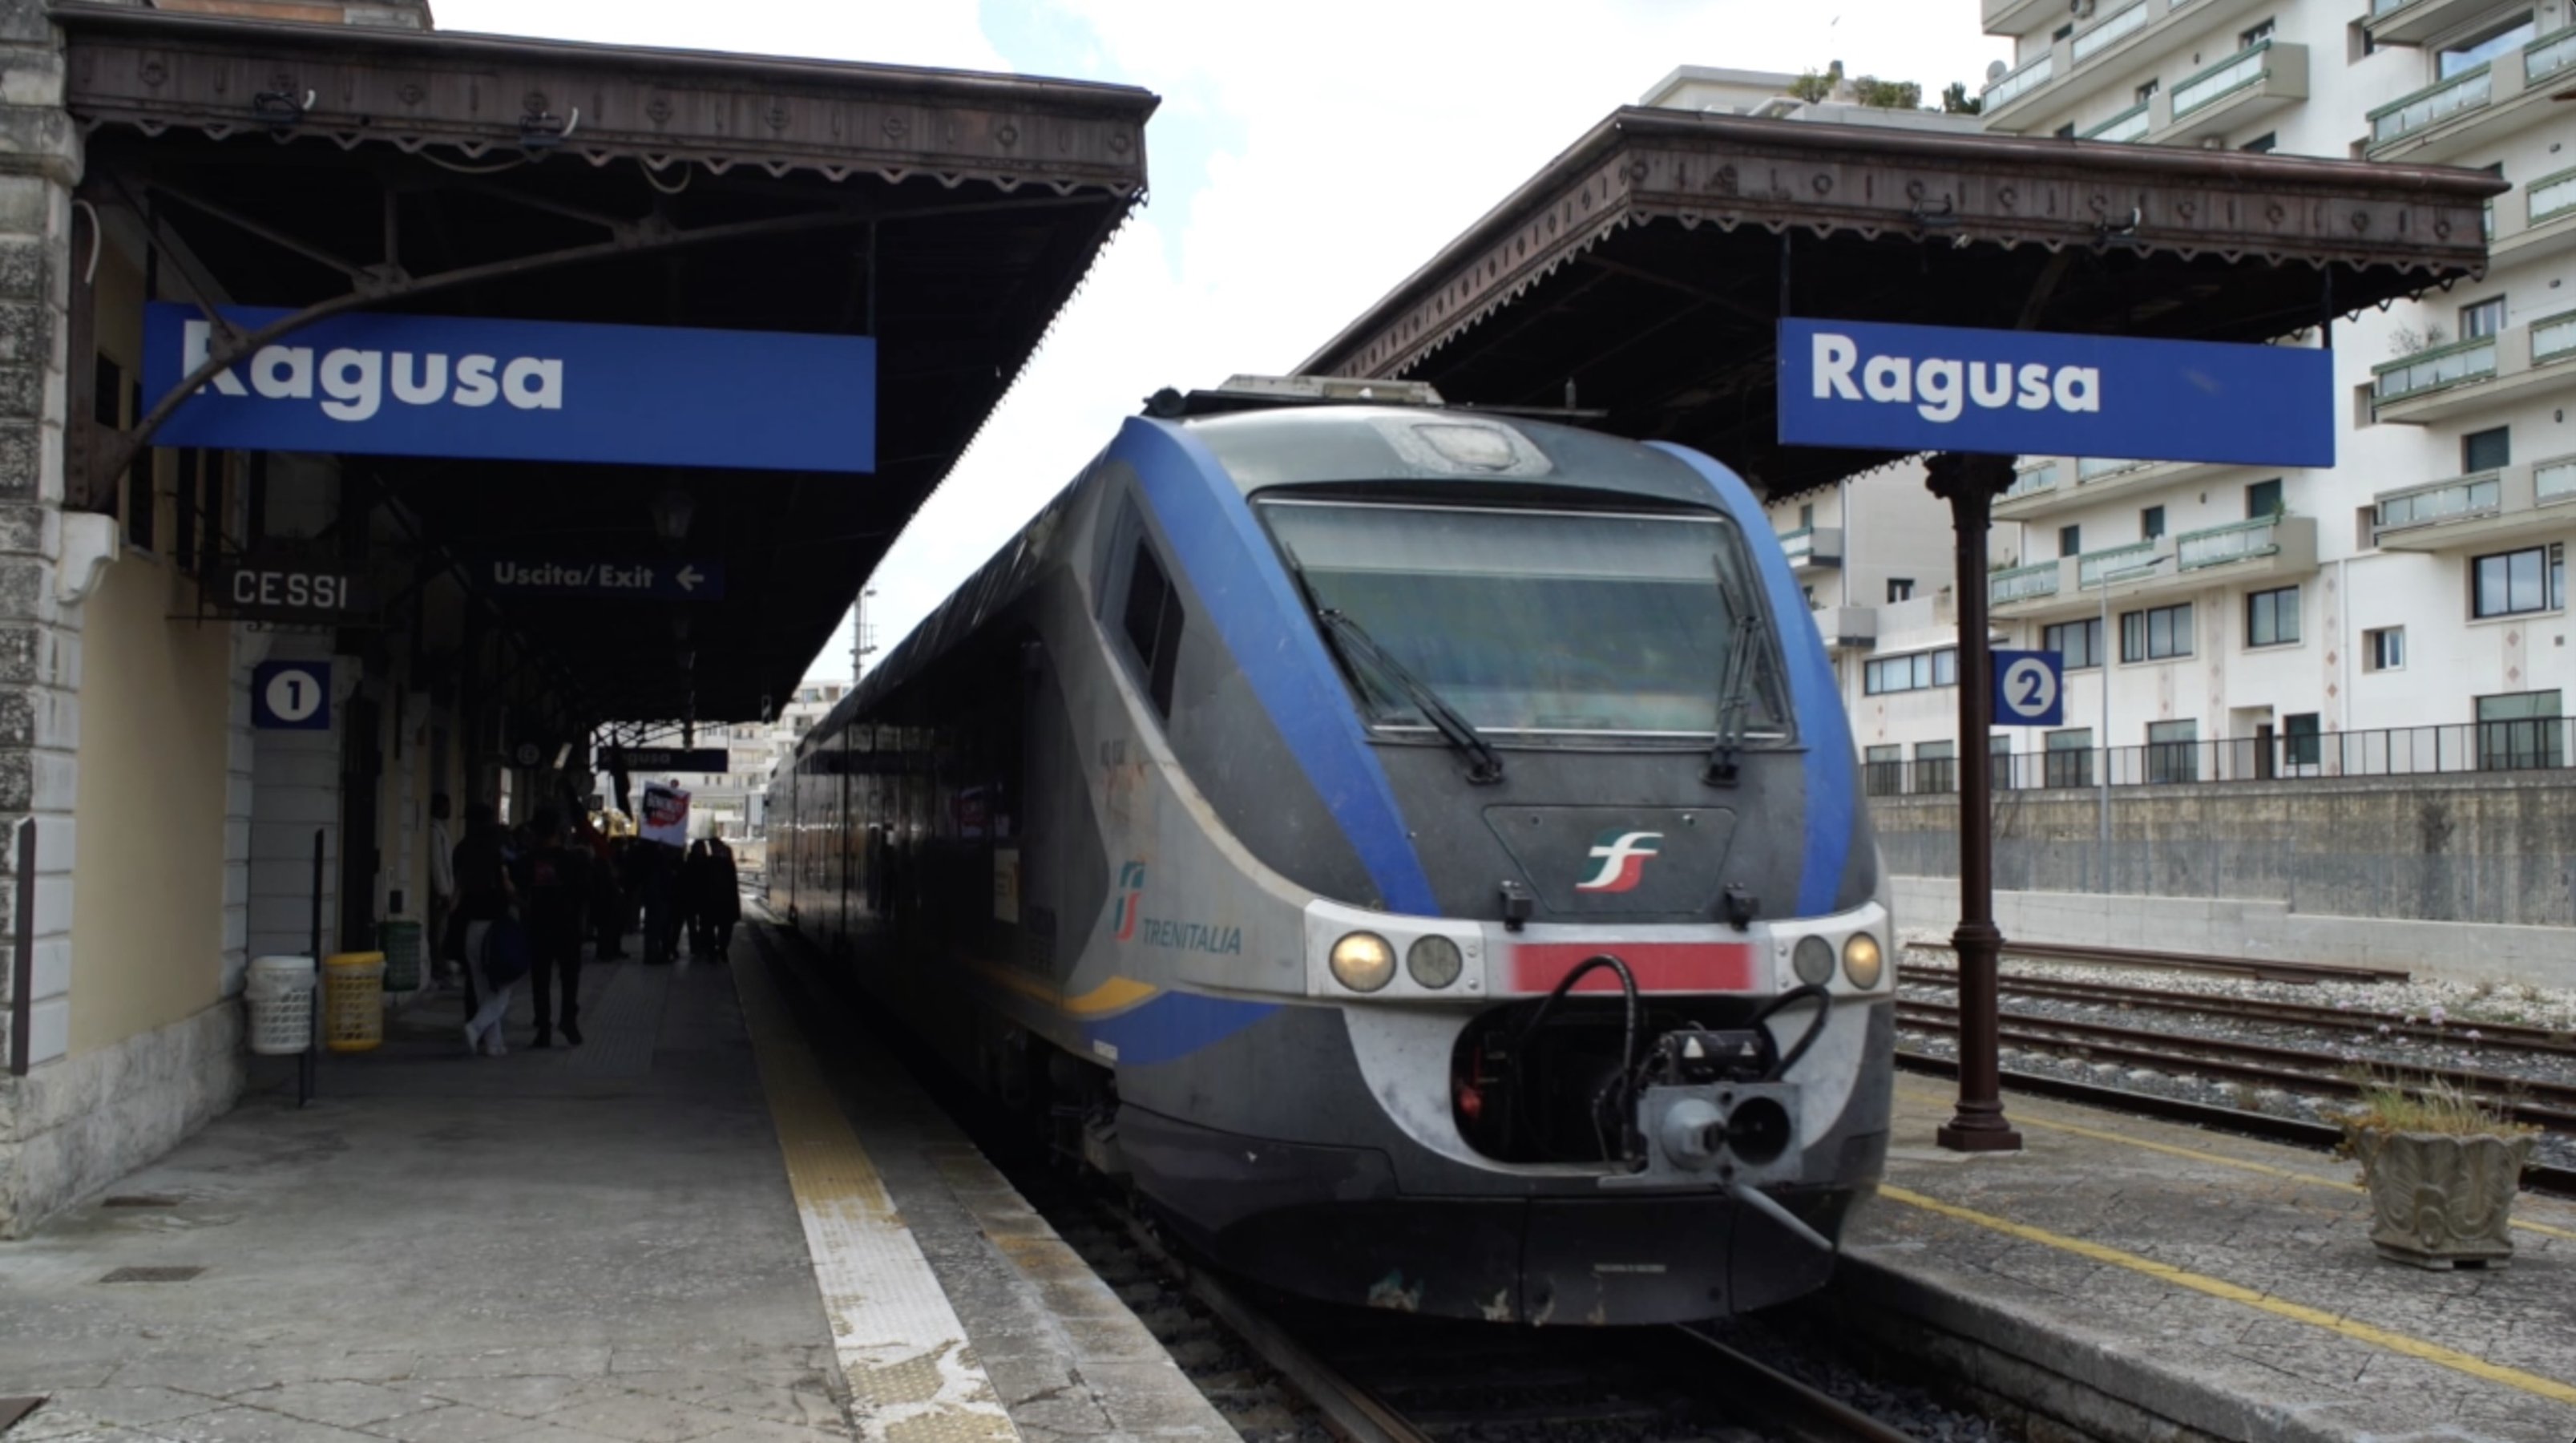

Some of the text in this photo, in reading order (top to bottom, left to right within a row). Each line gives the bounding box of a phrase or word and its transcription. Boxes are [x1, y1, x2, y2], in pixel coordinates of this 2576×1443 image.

[1812, 333, 2099, 422] Ragusa
[233, 570, 346, 608] CESSI
[286, 680, 301, 711] 1
[2017, 669, 2042, 706] 2
[1143, 918, 1241, 956] TRENITALIA
